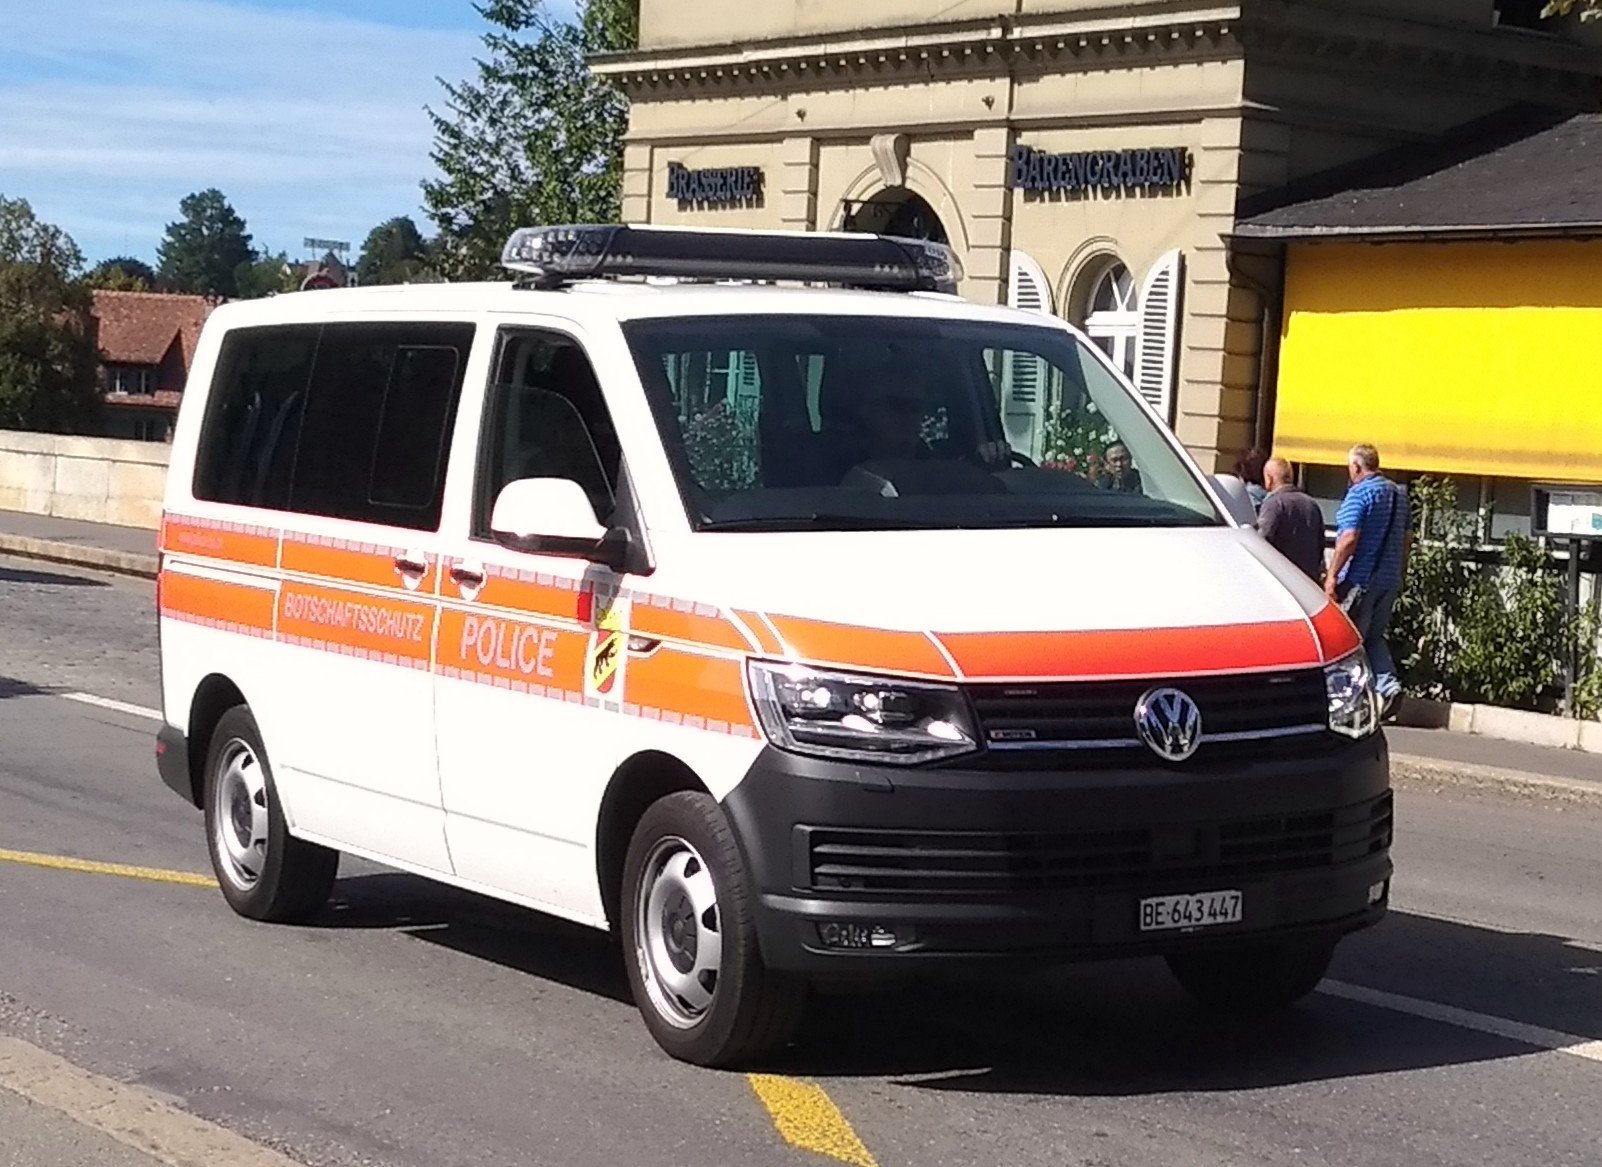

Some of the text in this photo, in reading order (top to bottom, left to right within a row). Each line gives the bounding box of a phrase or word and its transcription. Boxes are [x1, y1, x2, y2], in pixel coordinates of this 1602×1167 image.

[666, 163, 754, 199] BRASSERIE
[284, 592, 424, 641] BOTSCHAFTSSCHUTZ
[461, 613, 558, 678] POLICE
